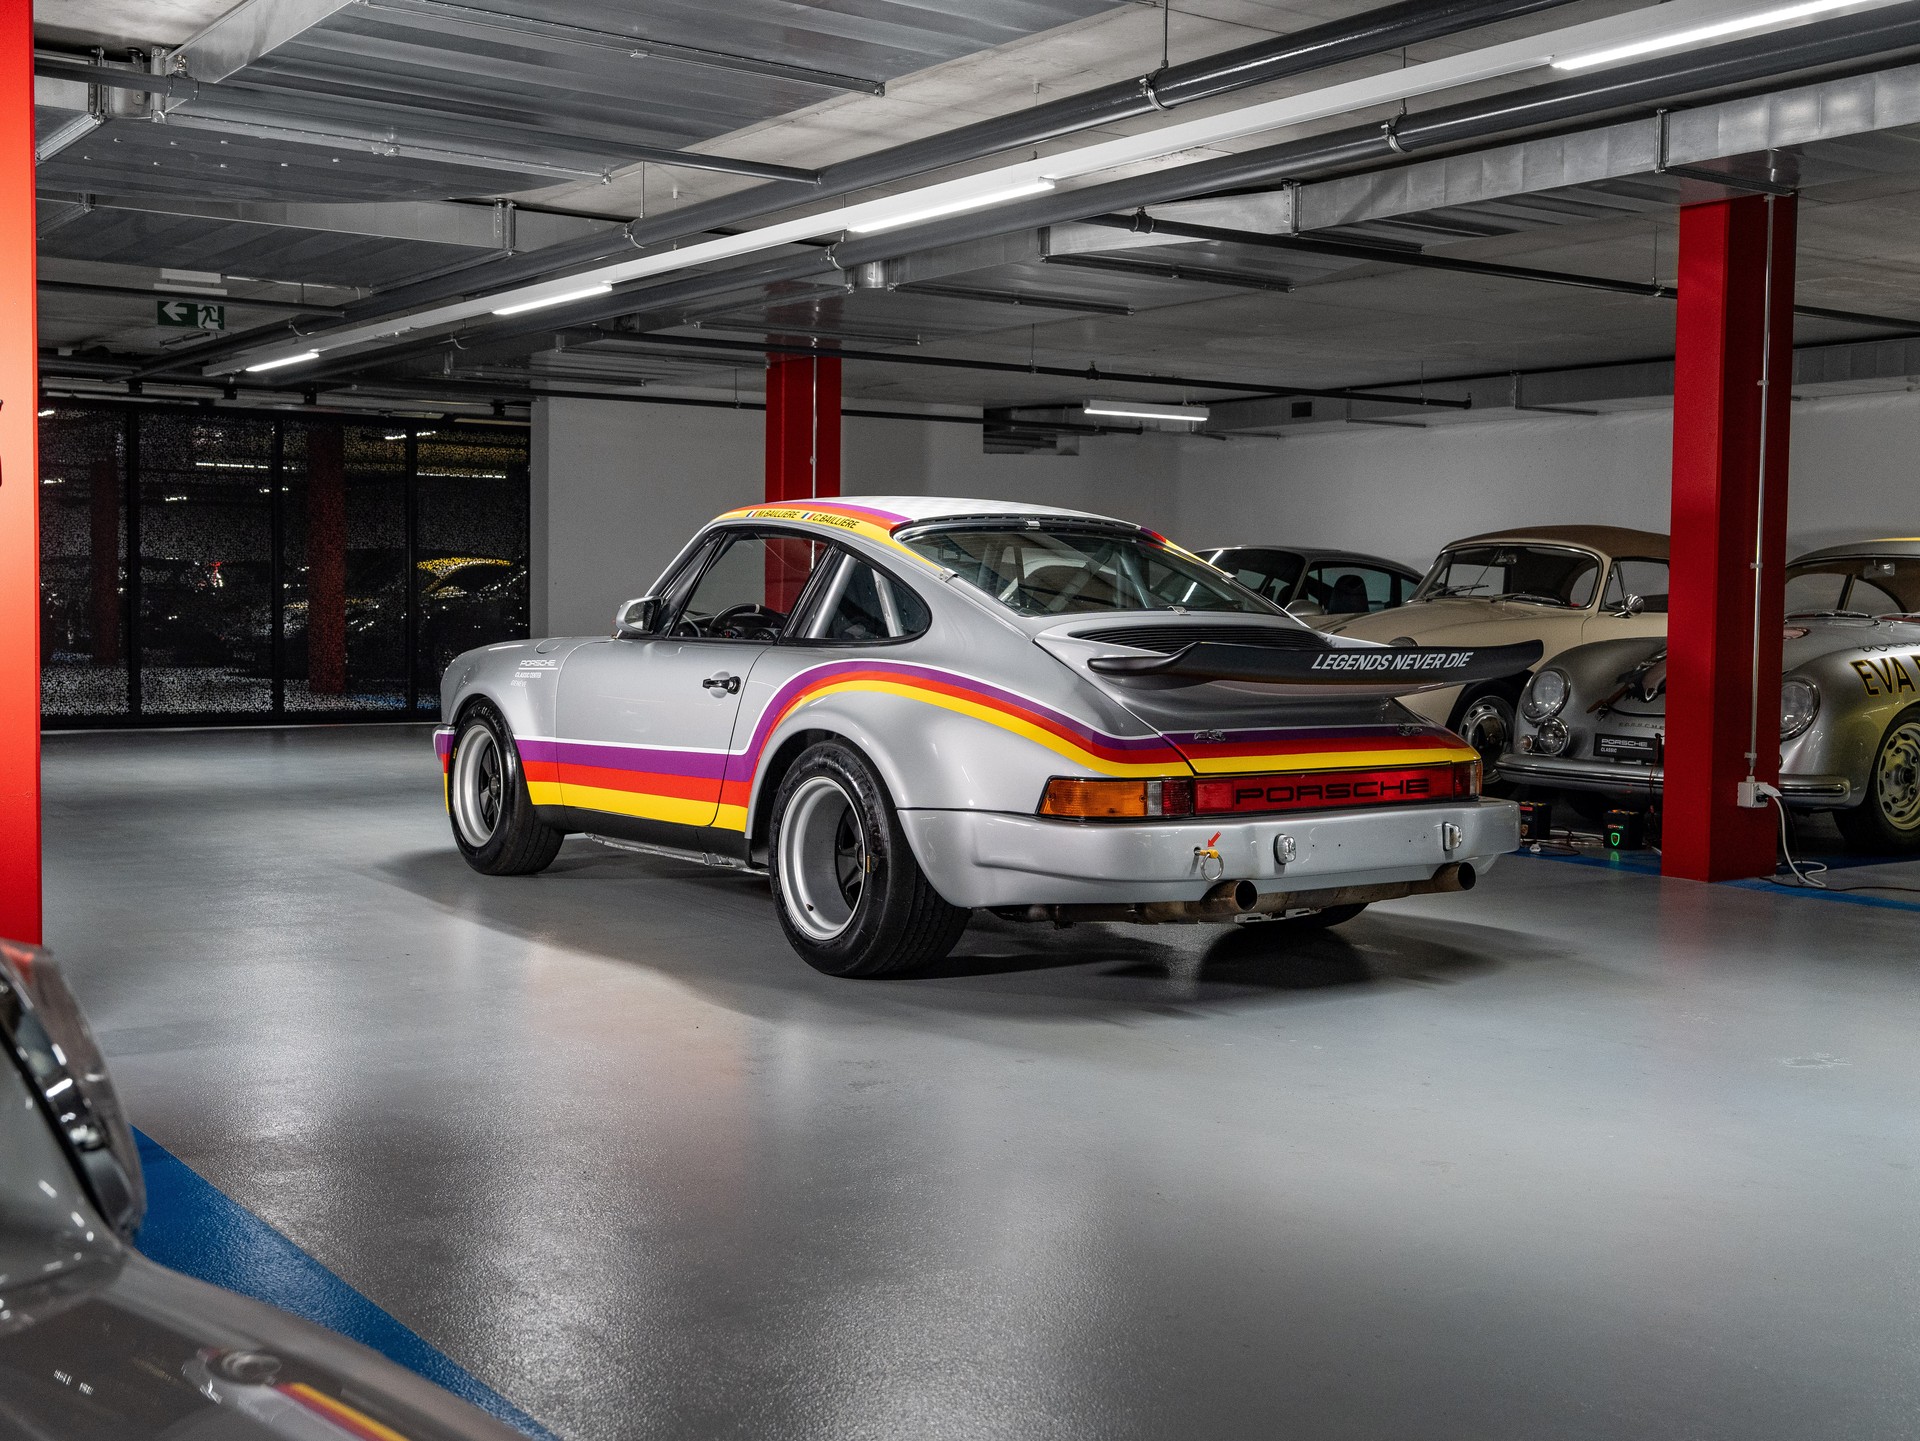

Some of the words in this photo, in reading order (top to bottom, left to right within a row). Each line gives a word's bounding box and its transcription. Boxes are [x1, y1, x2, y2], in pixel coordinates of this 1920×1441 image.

[1311, 654, 1392, 671] LEGENDS
[1390, 653, 1446, 670] NEVER
[1443, 651, 1474, 668] DIE
[1849, 656, 1916, 696] EVA
[1601, 738, 1648, 748] PORSCHE
[1235, 778, 1429, 804] PORSCHE
